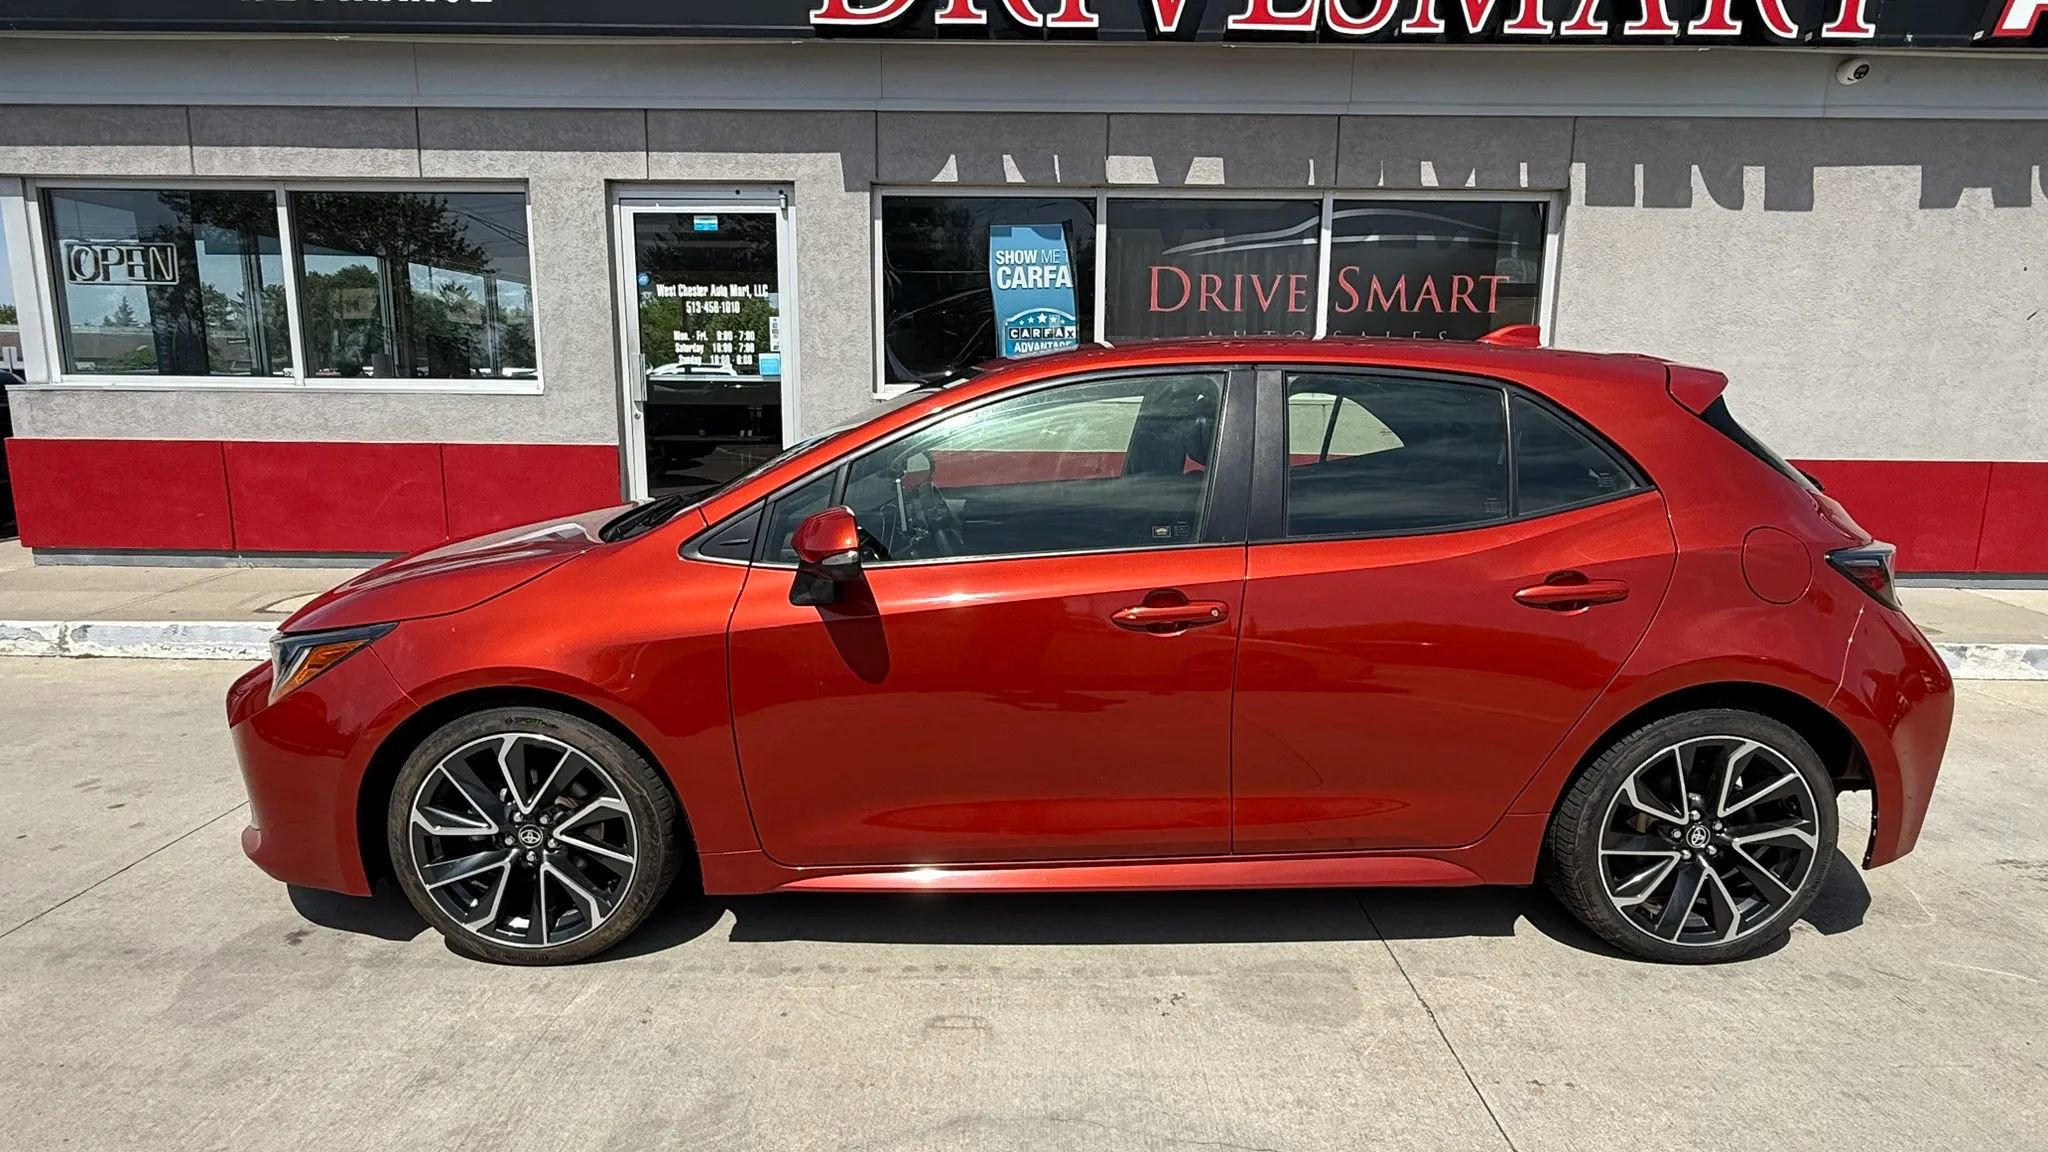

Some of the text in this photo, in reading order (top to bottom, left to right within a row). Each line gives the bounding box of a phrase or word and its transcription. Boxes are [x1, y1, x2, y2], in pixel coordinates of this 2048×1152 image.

[70, 246, 174, 281] OPEN
[995, 249, 1037, 265] SHOW
[1041, 249, 1060, 263] ME
[996, 265, 1074, 290] CARFA
[656, 284, 677, 297] West
[678, 284, 708, 297] Chester
[710, 284, 728, 297] Auto
[754, 284, 769, 297] LLC
[1148, 265, 1511, 314] DRIVE SMART
[1010, 328, 1076, 339] CARFAX
[675, 342, 704, 354] Saturday
[678, 354, 702, 365] Sunday
